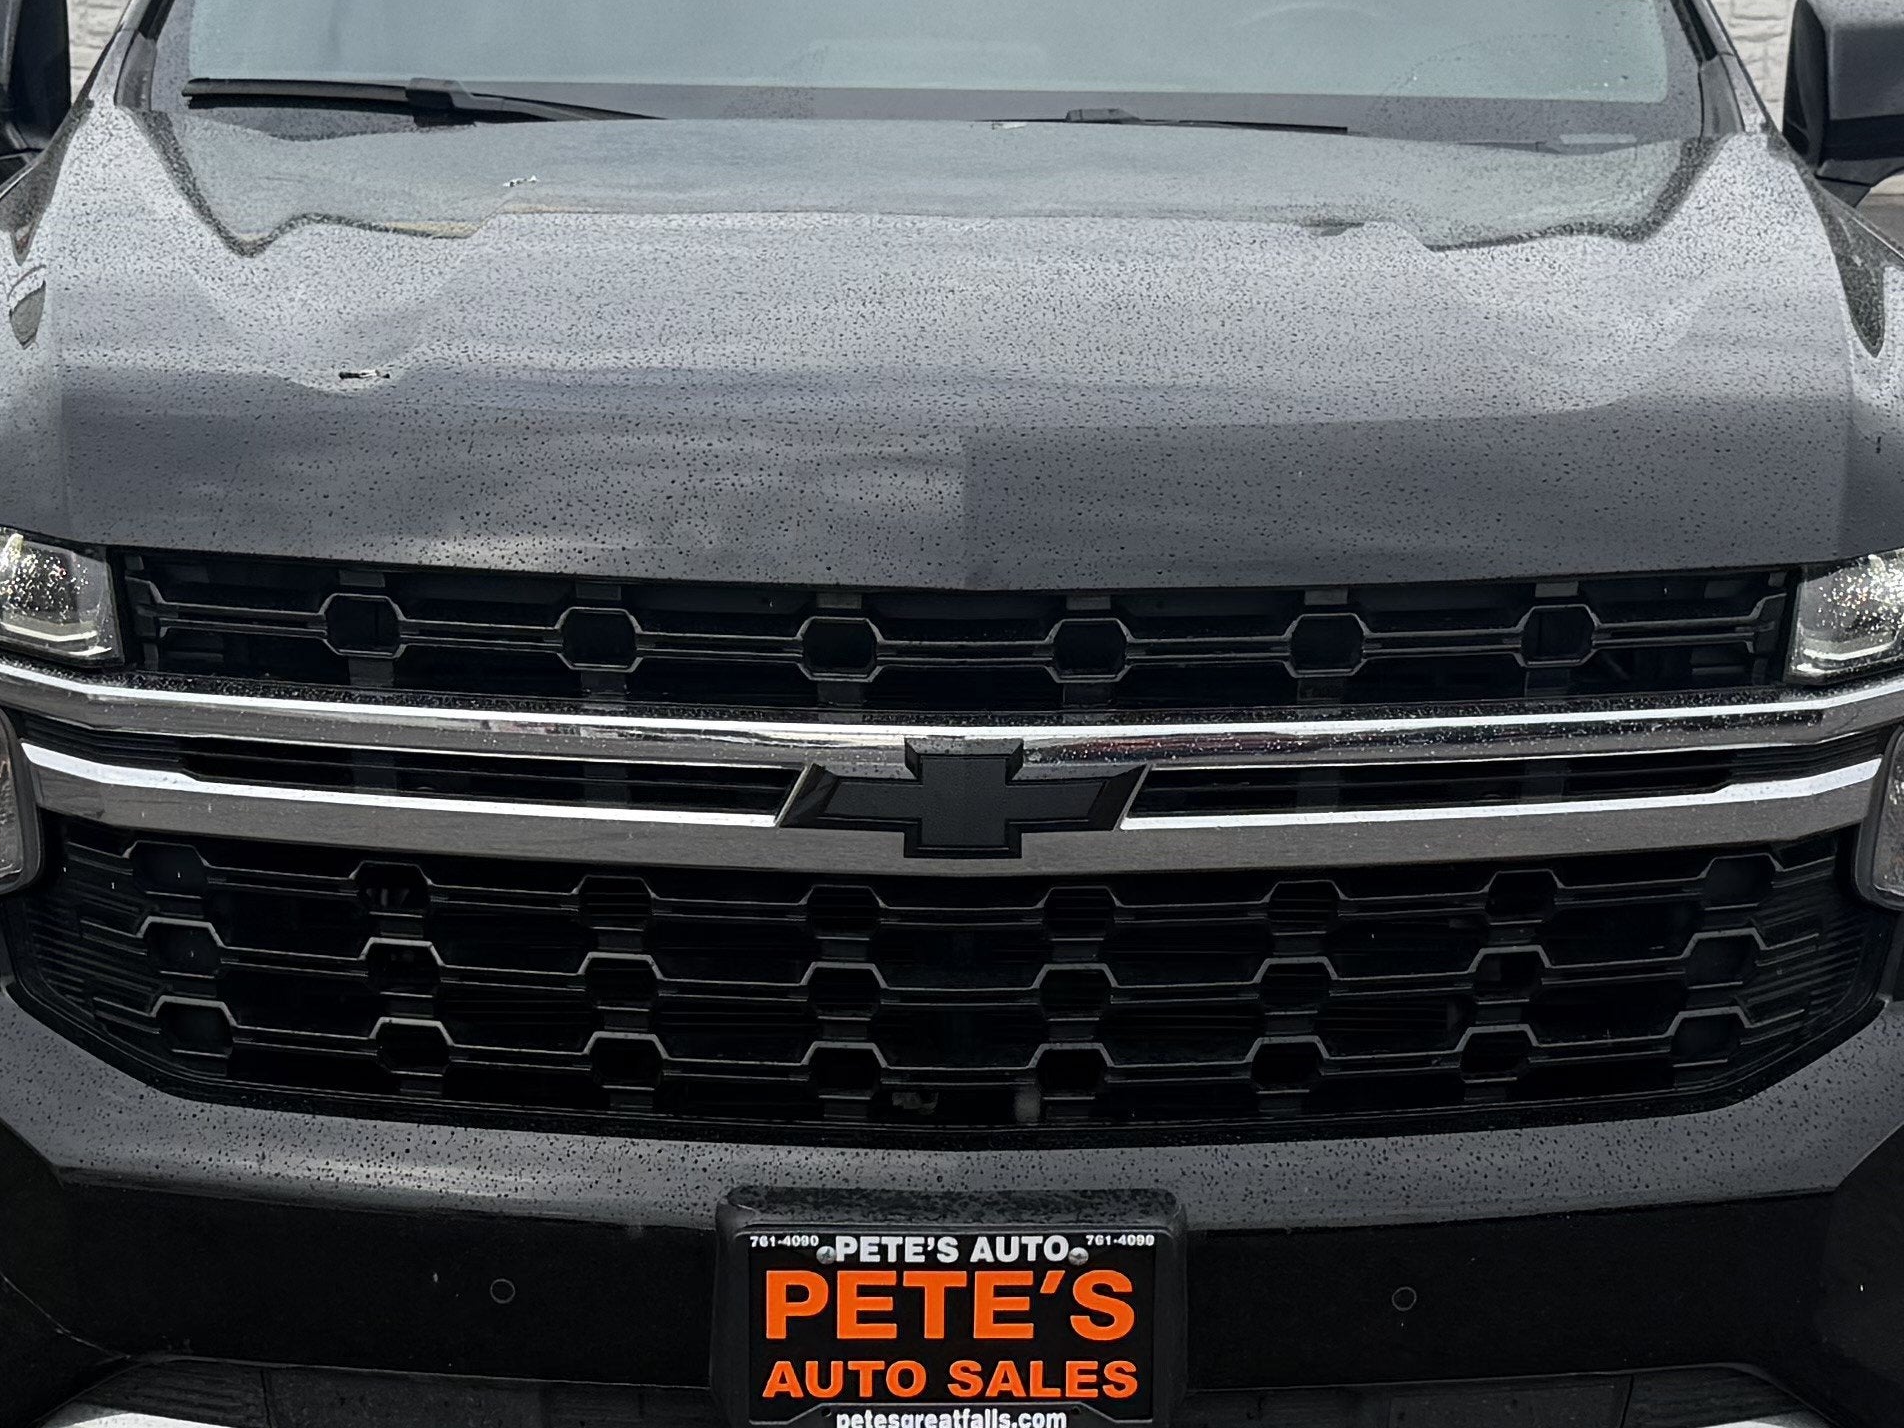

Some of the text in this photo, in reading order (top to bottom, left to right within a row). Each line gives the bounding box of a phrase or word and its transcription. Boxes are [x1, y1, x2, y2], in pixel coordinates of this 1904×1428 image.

[749, 1234, 820, 1248] 761-4090
[835, 1234, 1069, 1264] PETE'S AUTO
[1085, 1233, 1156, 1247] 761-4090
[765, 1269, 1135, 1341] PETE'S
[762, 1360, 1139, 1399] AUTO SALES
